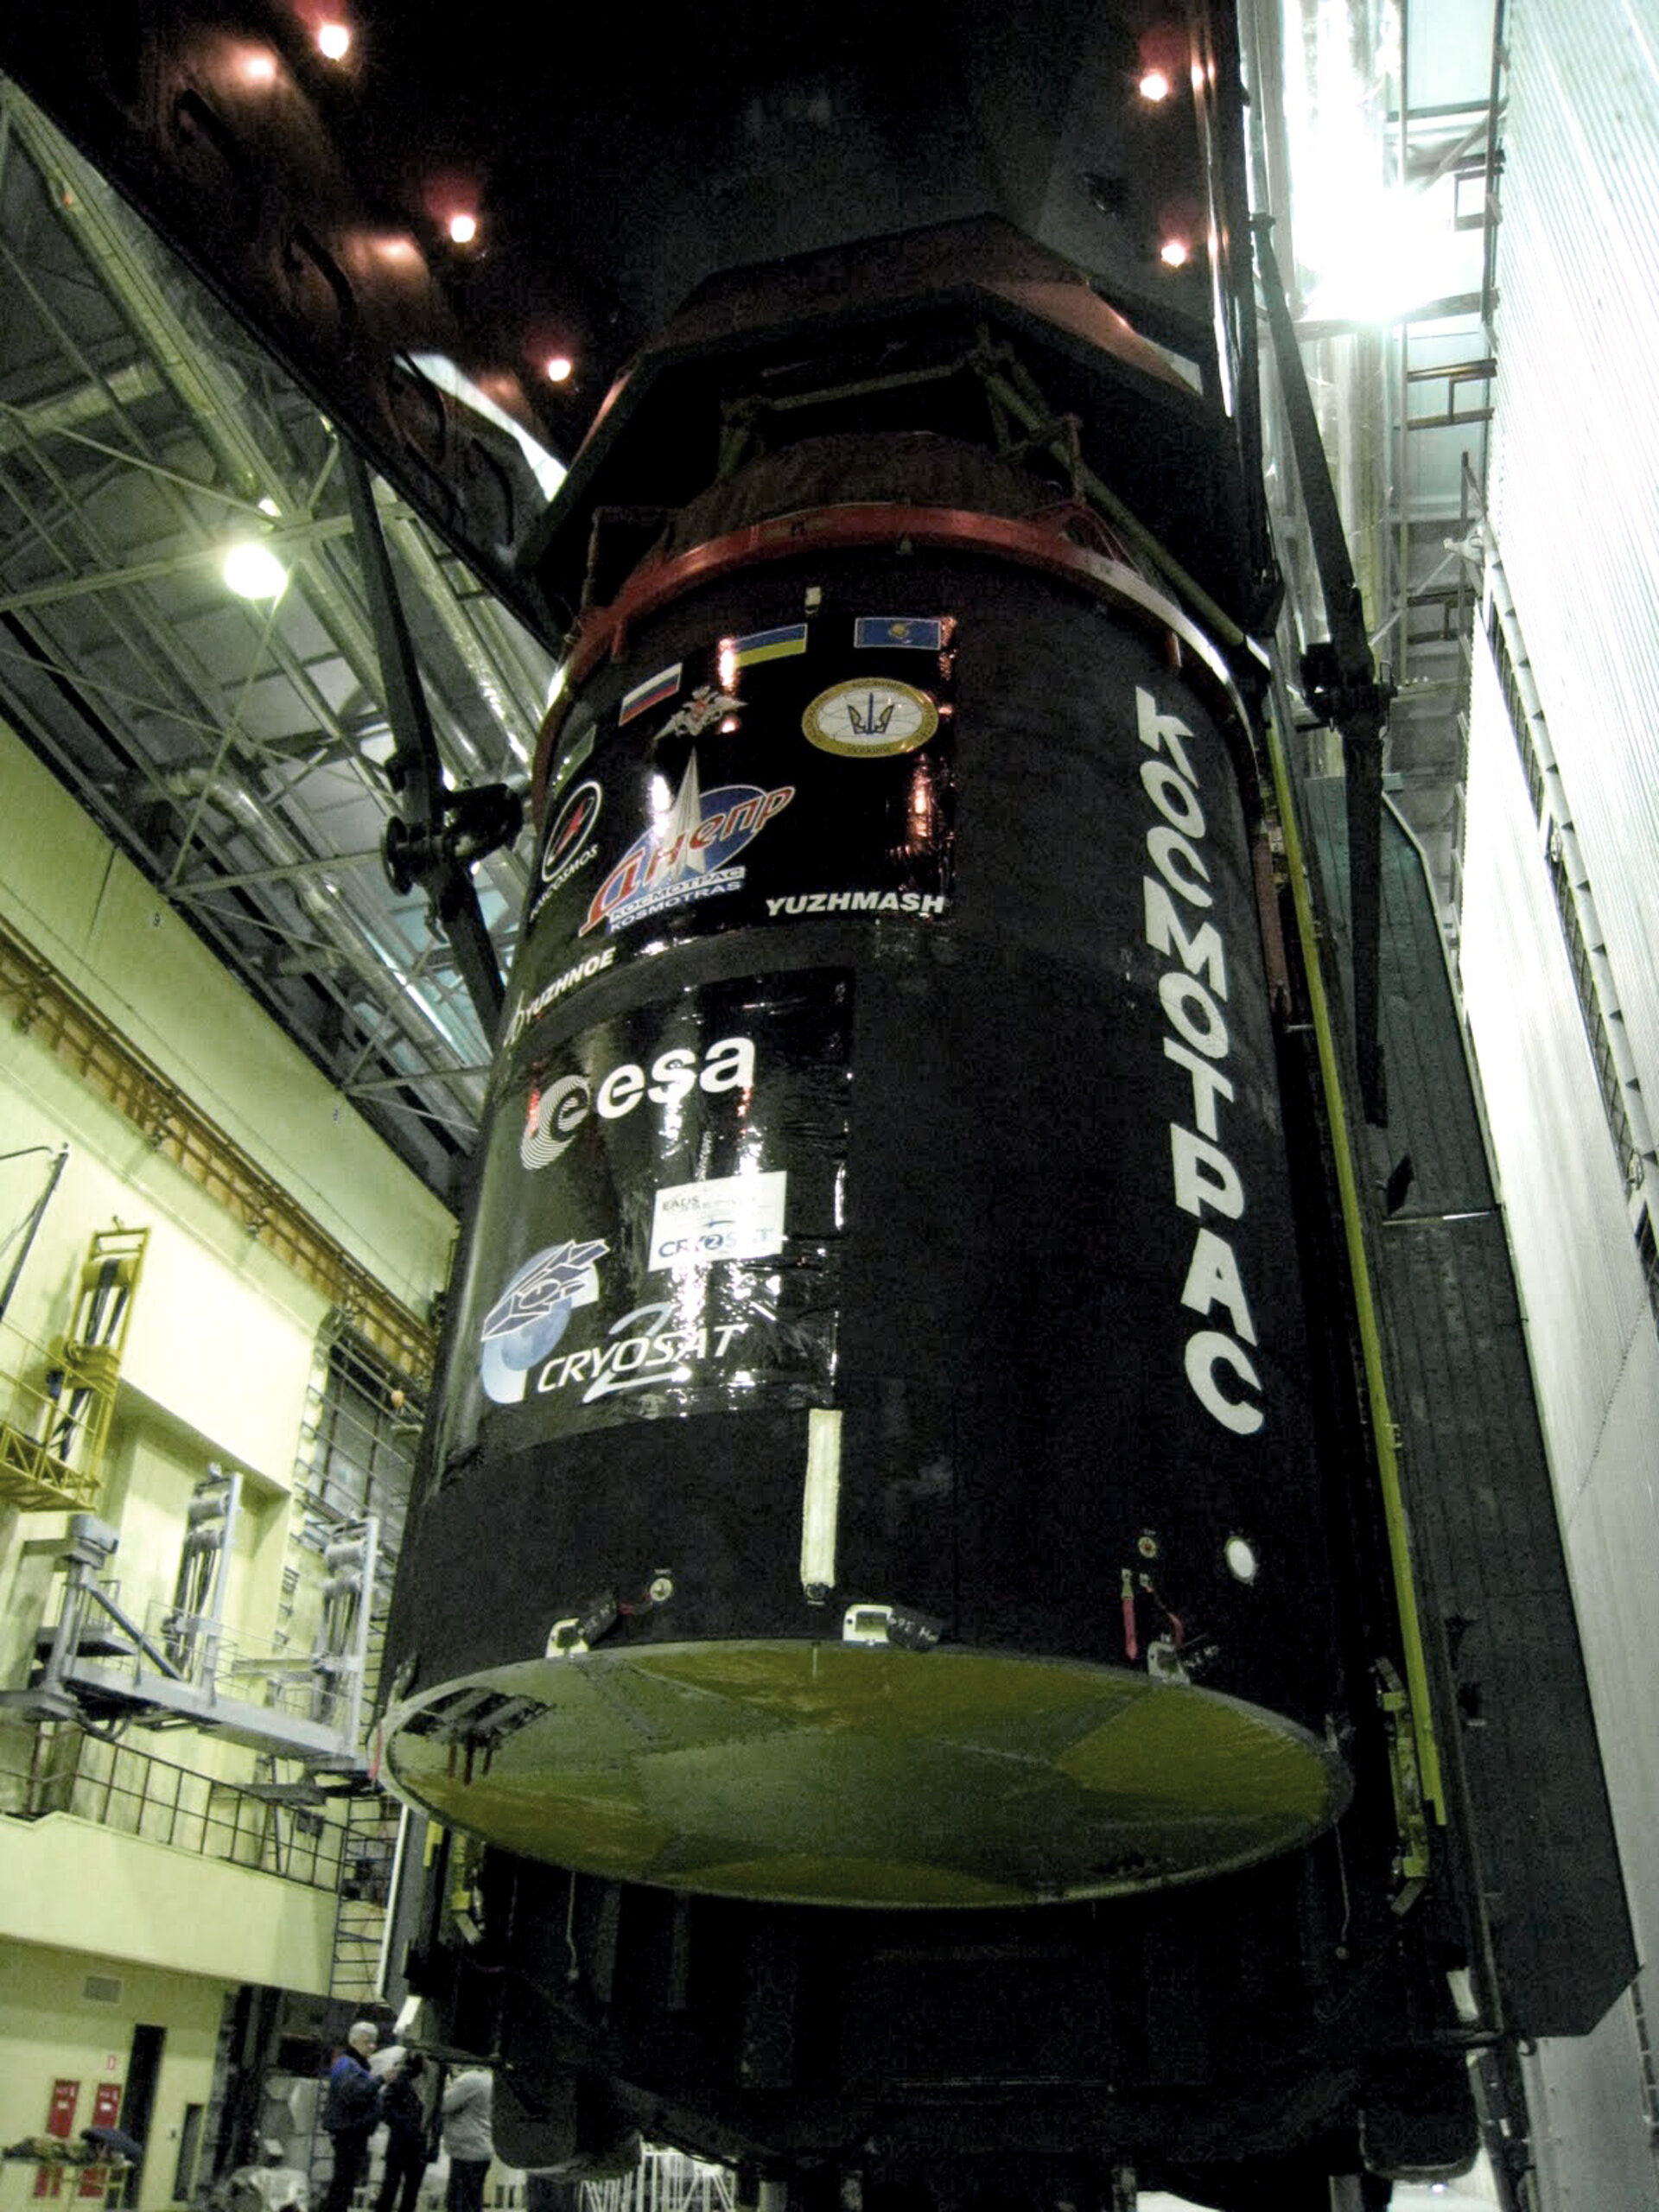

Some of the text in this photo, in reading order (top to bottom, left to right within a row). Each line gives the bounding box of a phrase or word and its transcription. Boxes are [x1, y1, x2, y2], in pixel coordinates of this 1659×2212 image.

[579, 786, 795, 938] Днепр
[610, 880, 741, 933] KOSMOTRAS
[766, 892, 945, 917] YUZHMASH
[597, 1037, 756, 1120] esa
[1135, 686, 1263, 1434] КОСМОТРАС
[537, 1323, 749, 1393] CRYOSAT
